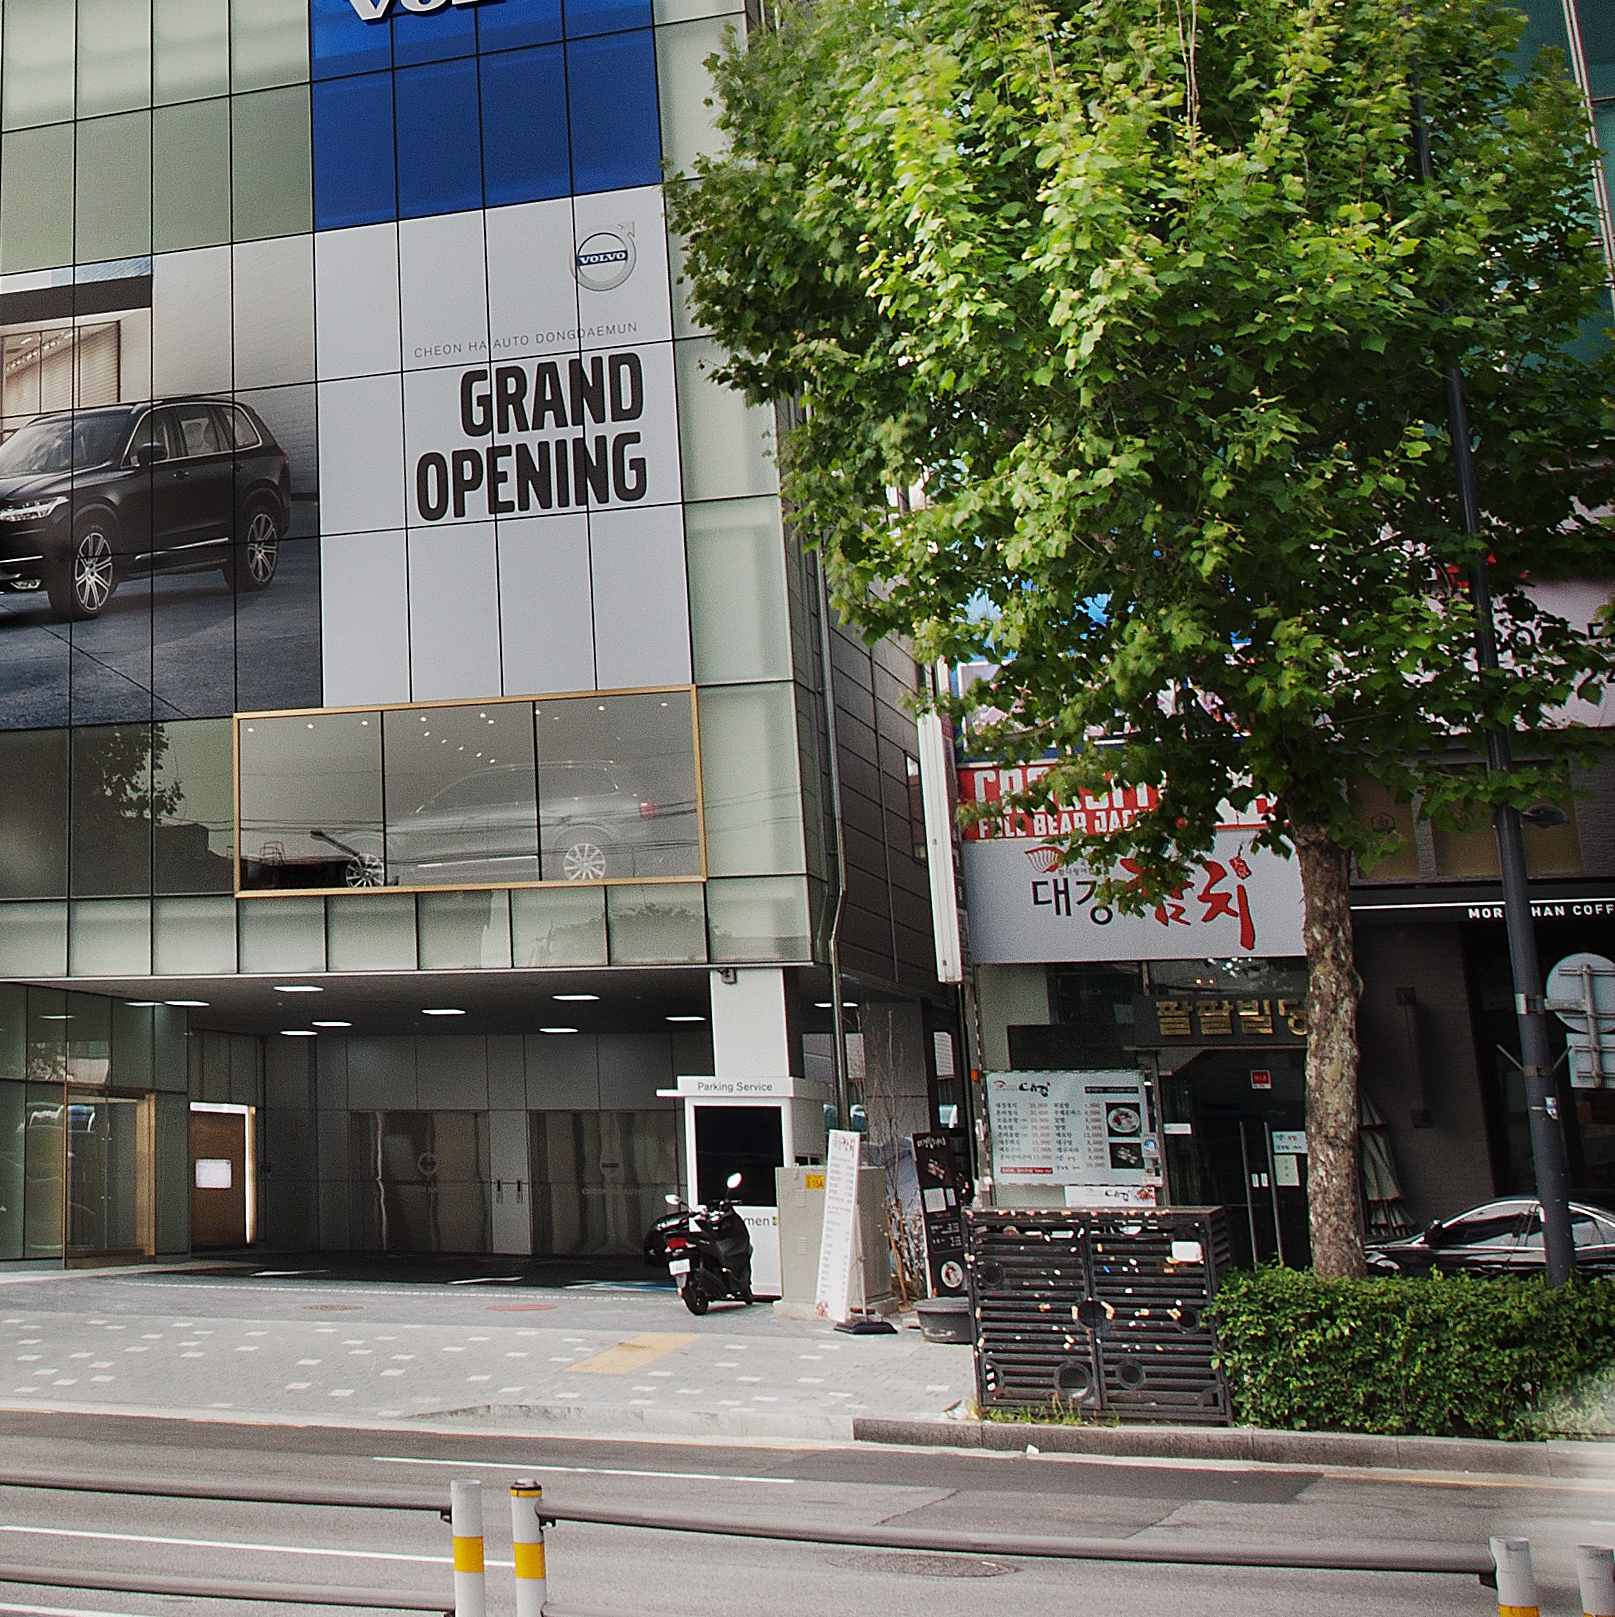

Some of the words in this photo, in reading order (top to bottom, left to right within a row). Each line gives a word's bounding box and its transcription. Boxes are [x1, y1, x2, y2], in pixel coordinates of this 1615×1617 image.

[579, 251, 627, 264] VOLVO
[414, 343, 462, 358] CHEON
[468, 341, 487, 351] HA
[493, 335, 529, 349] AUTO
[535, 322, 638, 344] DONGDAEMUN
[459, 351, 644, 437] GRAND
[416, 430, 648, 522] OPENING
[1033, 811, 1087, 836] BEAR
[1469, 907, 1505, 919] MOR
[1530, 905, 1566, 918] HAN
[697, 1081, 734, 1093] Parking
[736, 1081, 773, 1091] Service
